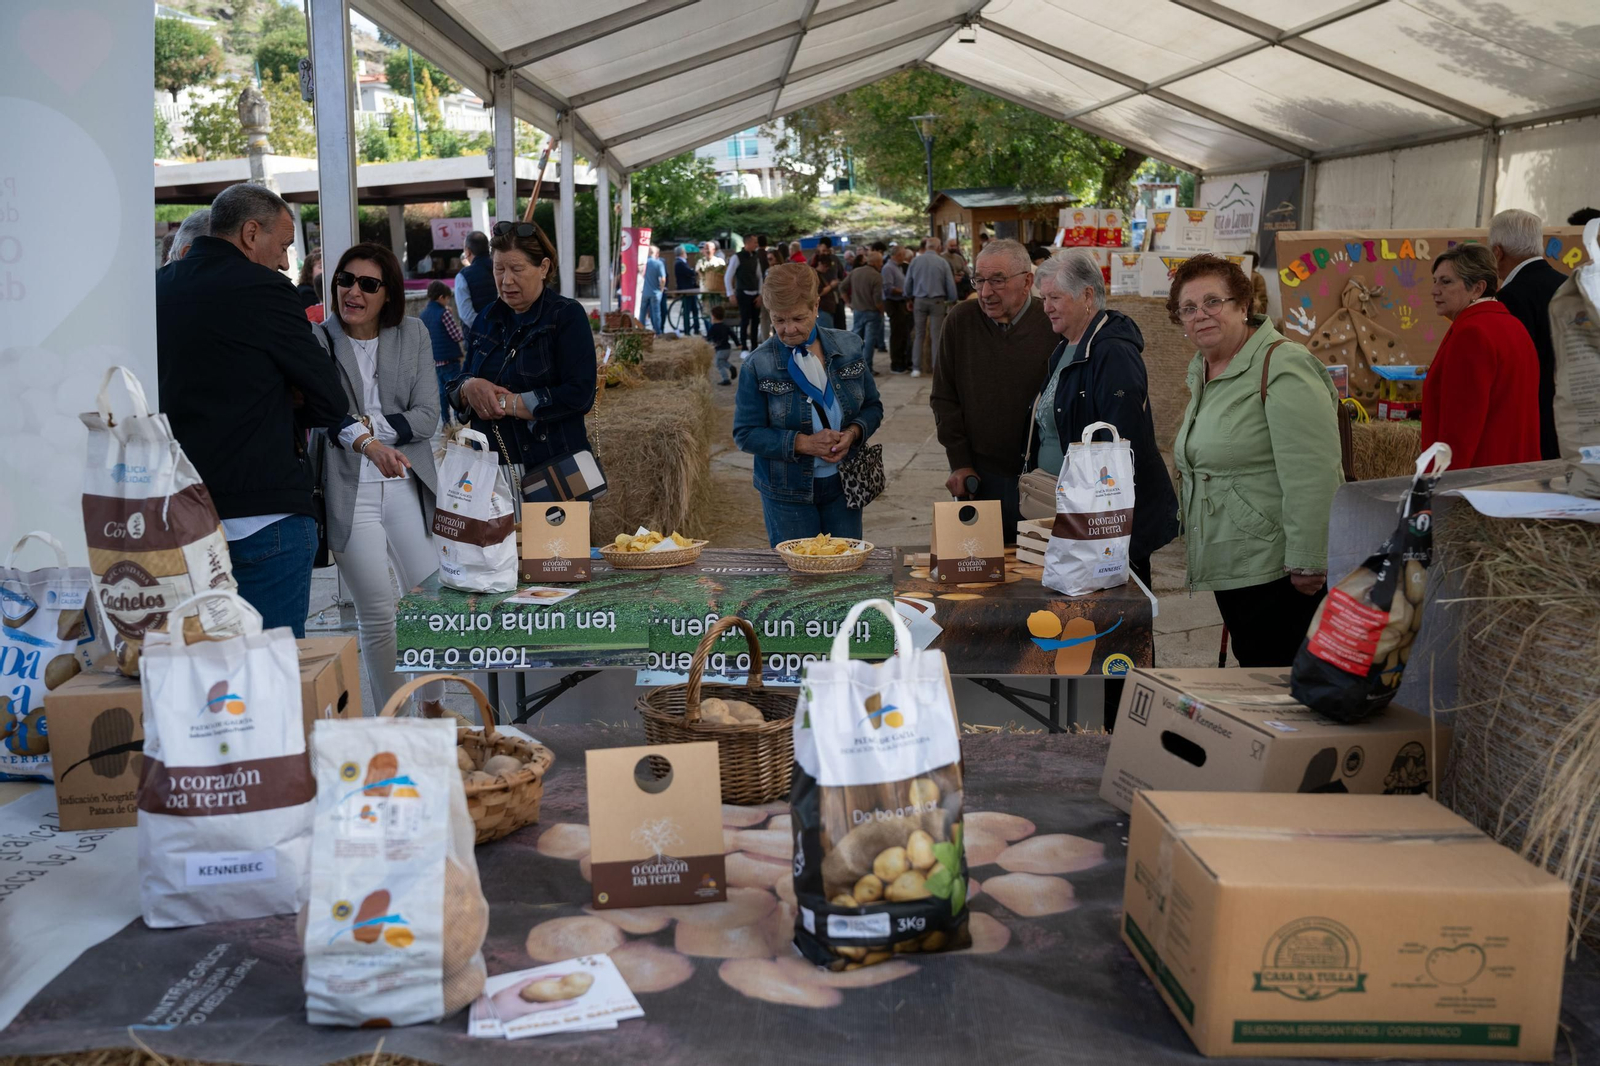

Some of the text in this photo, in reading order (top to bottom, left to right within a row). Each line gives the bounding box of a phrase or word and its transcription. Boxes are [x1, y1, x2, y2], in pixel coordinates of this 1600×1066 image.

[1279, 247, 1329, 287] CEIP
[1345, 239, 1430, 263] VILAR
[100, 588, 166, 612] Cachelos
[502, 611, 565, 635] unha
[575, 610, 617, 633] ten
[764, 618, 795, 637] un
[403, 646, 532, 669] Todo o bo
[736, 653, 751, 670] o
[1196, 714, 1233, 740] Kennebec
[179, 767, 262, 792] corazón
[60, 793, 99, 806] Indicación
[89, 802, 138, 816] Pataca de Ga
[853, 809, 872, 825] Do
[875, 807, 894, 821] bo
[198, 861, 264, 877] KENNEBEC
[641, 860, 689, 875] corazón
[896, 916, 927, 932] 3Kg
[1264, 971, 1295, 981] CASA
